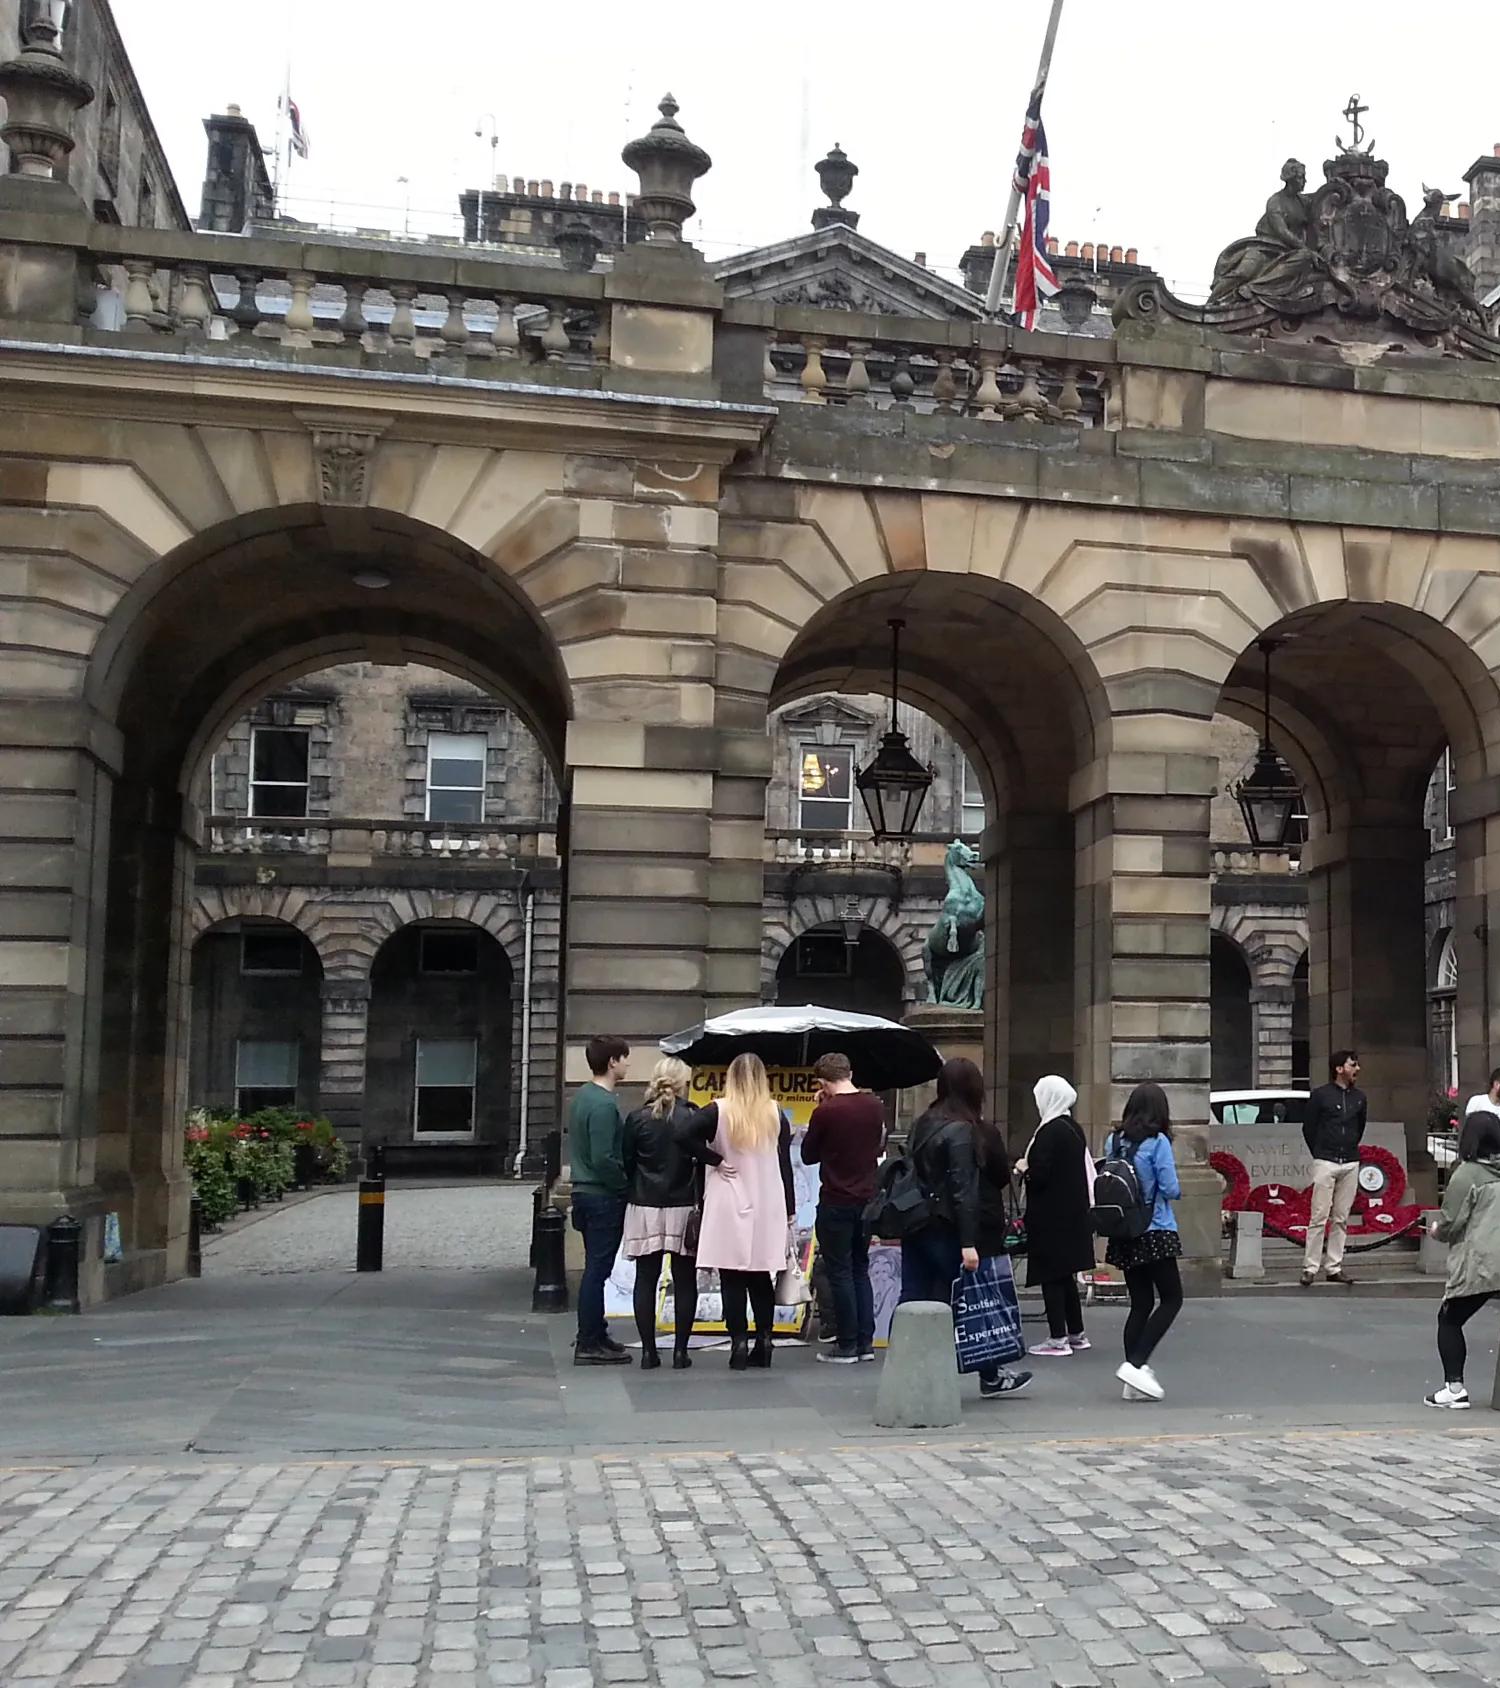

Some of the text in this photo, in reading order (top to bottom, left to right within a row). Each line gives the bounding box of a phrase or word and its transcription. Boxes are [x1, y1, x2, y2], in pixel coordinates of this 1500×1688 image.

[786, 1093, 816, 1102] minut
[1246, 1143, 1290, 1155] NAME
[954, 1324, 1017, 1343] Experience
